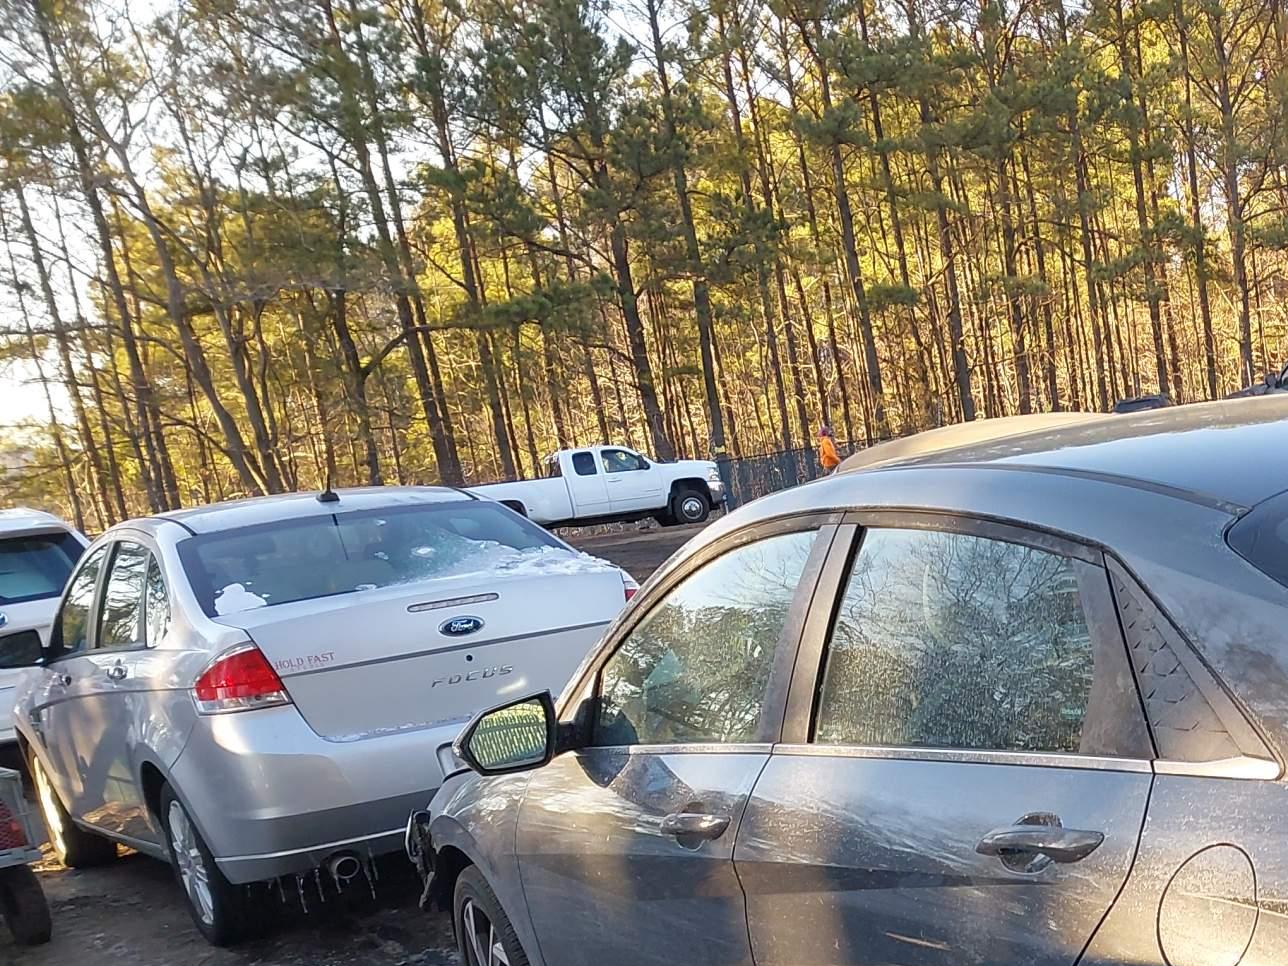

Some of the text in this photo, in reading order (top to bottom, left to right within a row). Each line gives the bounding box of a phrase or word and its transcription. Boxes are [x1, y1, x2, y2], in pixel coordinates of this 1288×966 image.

[275, 656, 304, 670] HOLD
[307, 652, 335, 664] FAST
[431, 664, 513, 688] FOCUS
